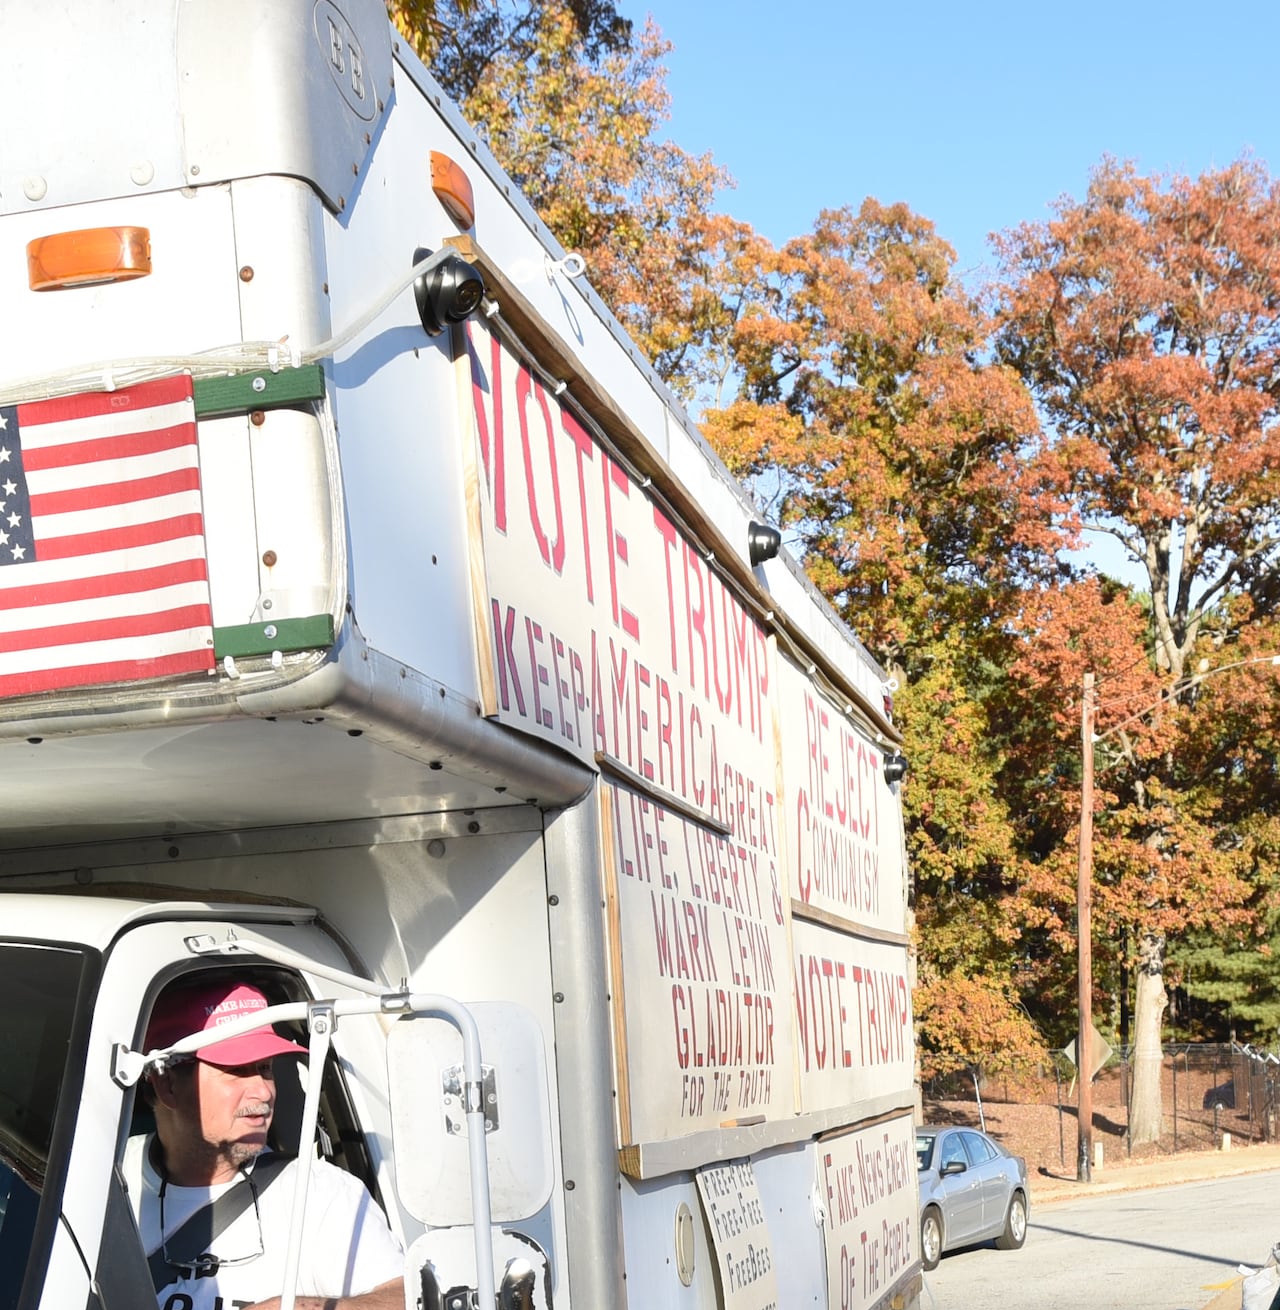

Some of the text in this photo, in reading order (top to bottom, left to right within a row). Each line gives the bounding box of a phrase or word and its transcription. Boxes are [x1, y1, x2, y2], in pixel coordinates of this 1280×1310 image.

[466, 320, 771, 744] VOTE TRUMP
[492, 597, 777, 858] KEEP AMERICA GREAT
[803, 688, 879, 847] REJECT
[682, 817, 762, 921] LIBERTY
[797, 786, 880, 917] COMMUNISM
[650, 889, 776, 993] MARK LEVIN
[204, 1000, 239, 1017] MAKE
[671, 983, 775, 1070] GLADIATOR
[793, 953, 907, 1073] VOTE TRUMP
[681, 1069, 771, 1118] FOR THE TRUTH
[823, 1133, 911, 1230] FAKE NEWS ENEMY
[860, 1230, 880, 1300] THE
[882, 1216, 911, 1285] PEOPLE
